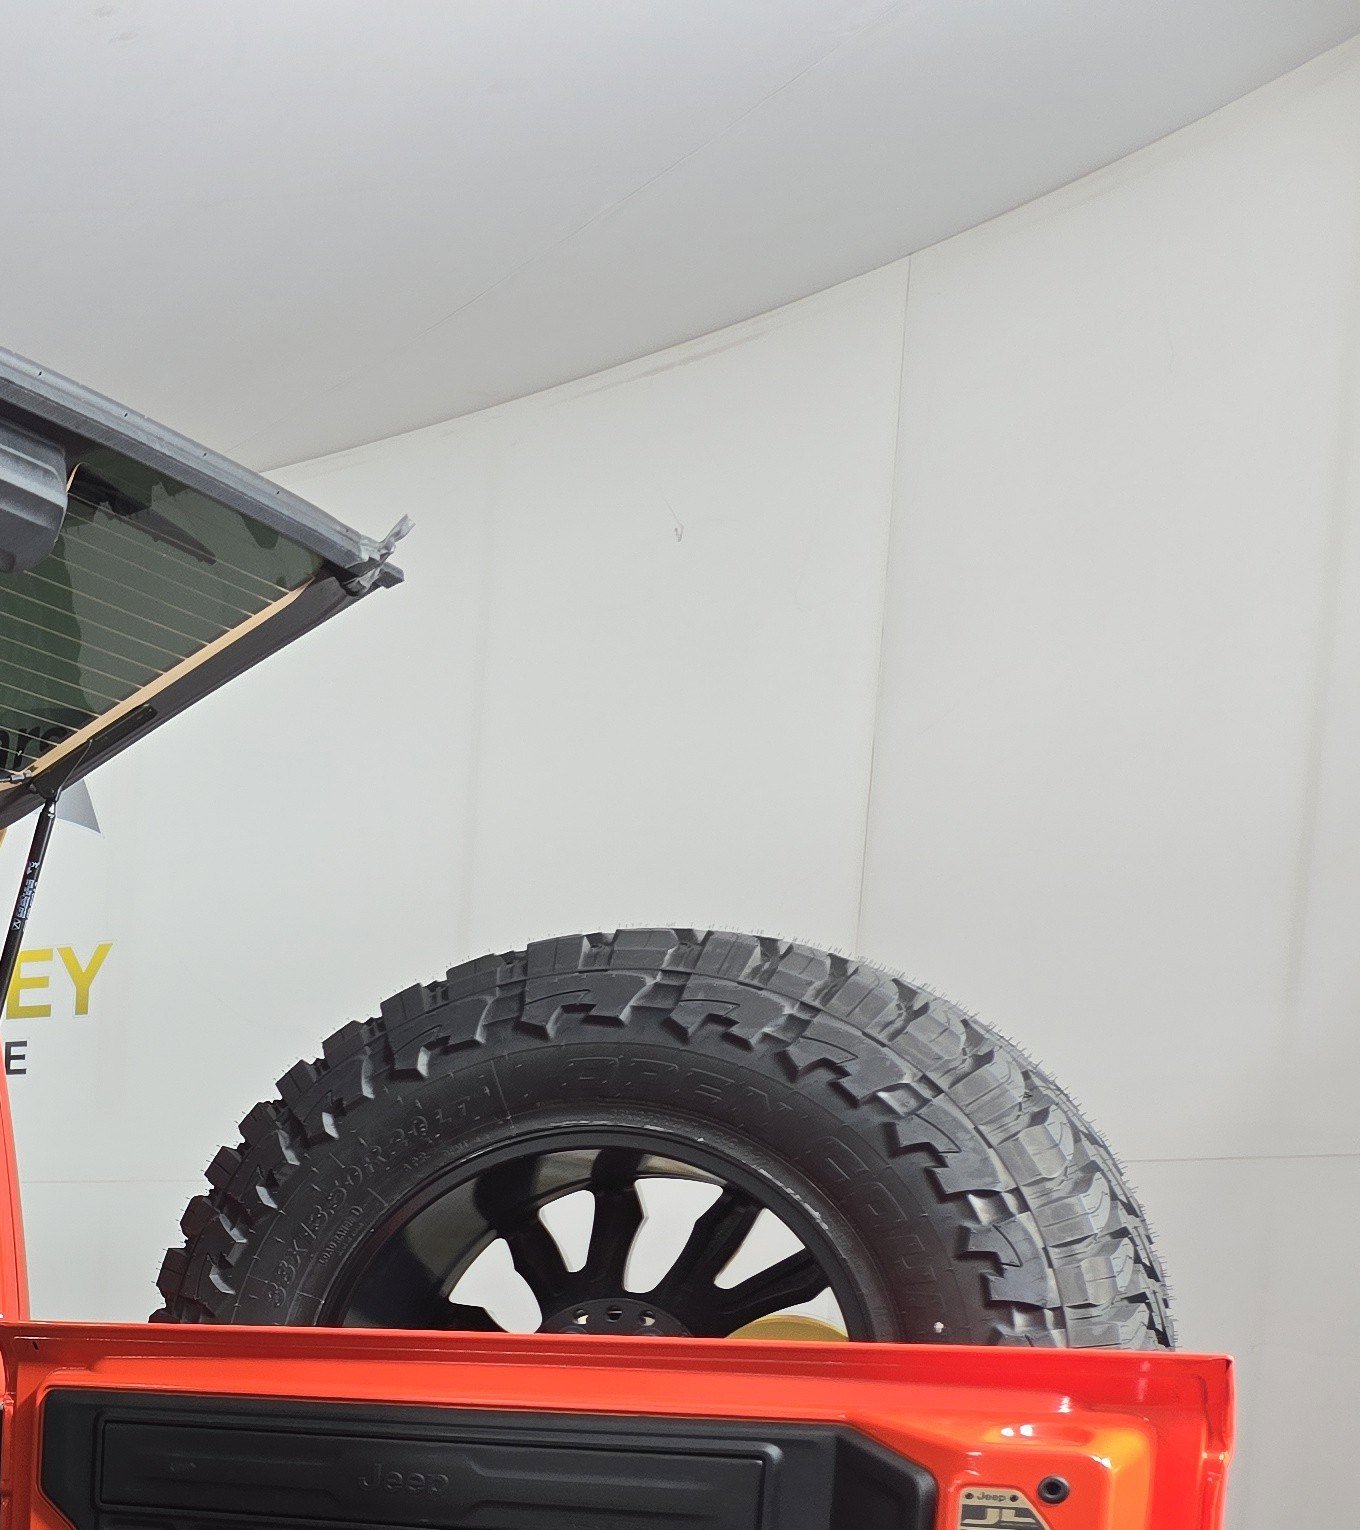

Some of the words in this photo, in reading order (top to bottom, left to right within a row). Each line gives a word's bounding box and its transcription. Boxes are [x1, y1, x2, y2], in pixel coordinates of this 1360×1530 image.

[357, 1462, 451, 1497] Jeep
[976, 1492, 1007, 1503] Jeep
[962, 1508, 1037, 1525] JL
